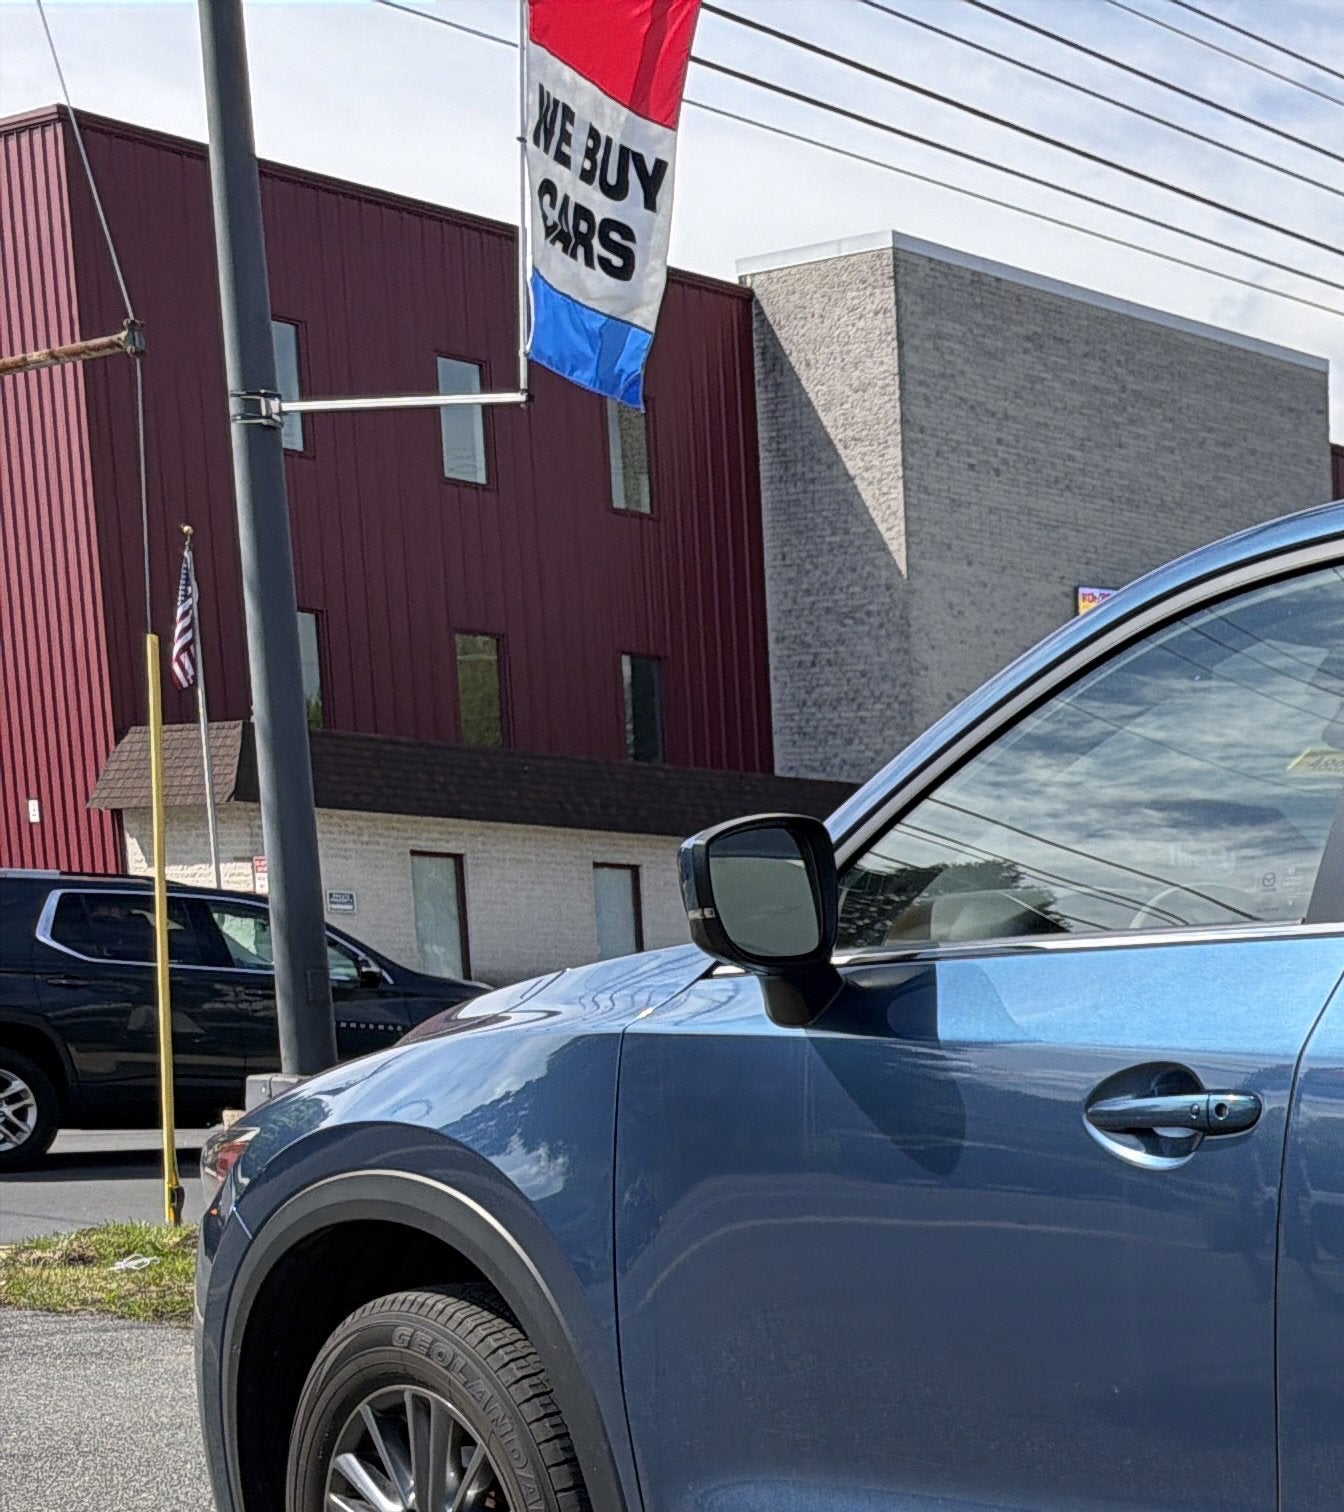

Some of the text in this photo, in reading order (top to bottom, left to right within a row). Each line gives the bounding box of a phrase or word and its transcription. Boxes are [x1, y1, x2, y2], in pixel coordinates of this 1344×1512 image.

[532, 82, 669, 213] WE BUY
[536, 177, 637, 282] CARS
